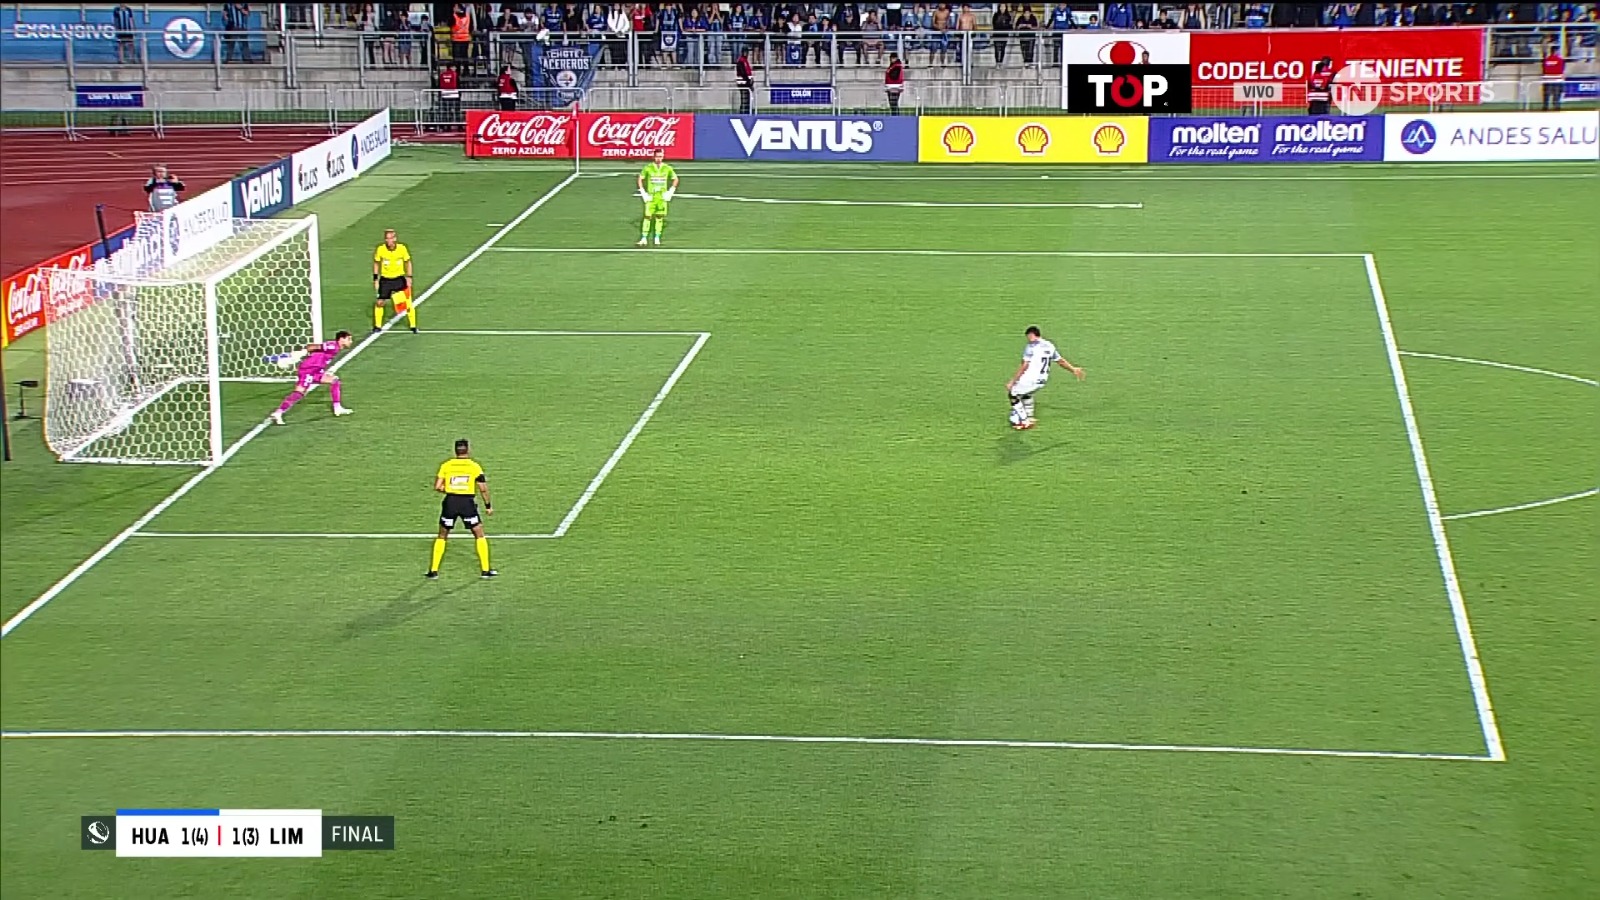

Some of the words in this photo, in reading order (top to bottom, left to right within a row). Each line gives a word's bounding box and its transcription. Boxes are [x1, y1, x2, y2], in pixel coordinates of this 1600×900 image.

[13, 23, 117, 39] EXCLUSIVO
[1197, 60, 1304, 80] CODELCO
[1345, 57, 1464, 78] TENIENTE
[477, 113, 571, 145] Coca-Cola
[588, 115, 680, 147] Coca-Cola
[1172, 122, 1260, 144] molten
[1275, 120, 1364, 142] molten
[1450, 126, 1532, 146] ANDES
[1537, 126, 1598, 145] SALU
[492, 147, 517, 155] ZERO
[519, 145, 555, 155] AZÚCAR
[602, 148, 627, 157] ZERO
[629, 147, 664, 157] AZÚC
[1169, 145, 1187, 157] For
[1187, 145, 1204, 155] the
[1272, 143, 1290, 155] For
[1290, 143, 1307, 154] the
